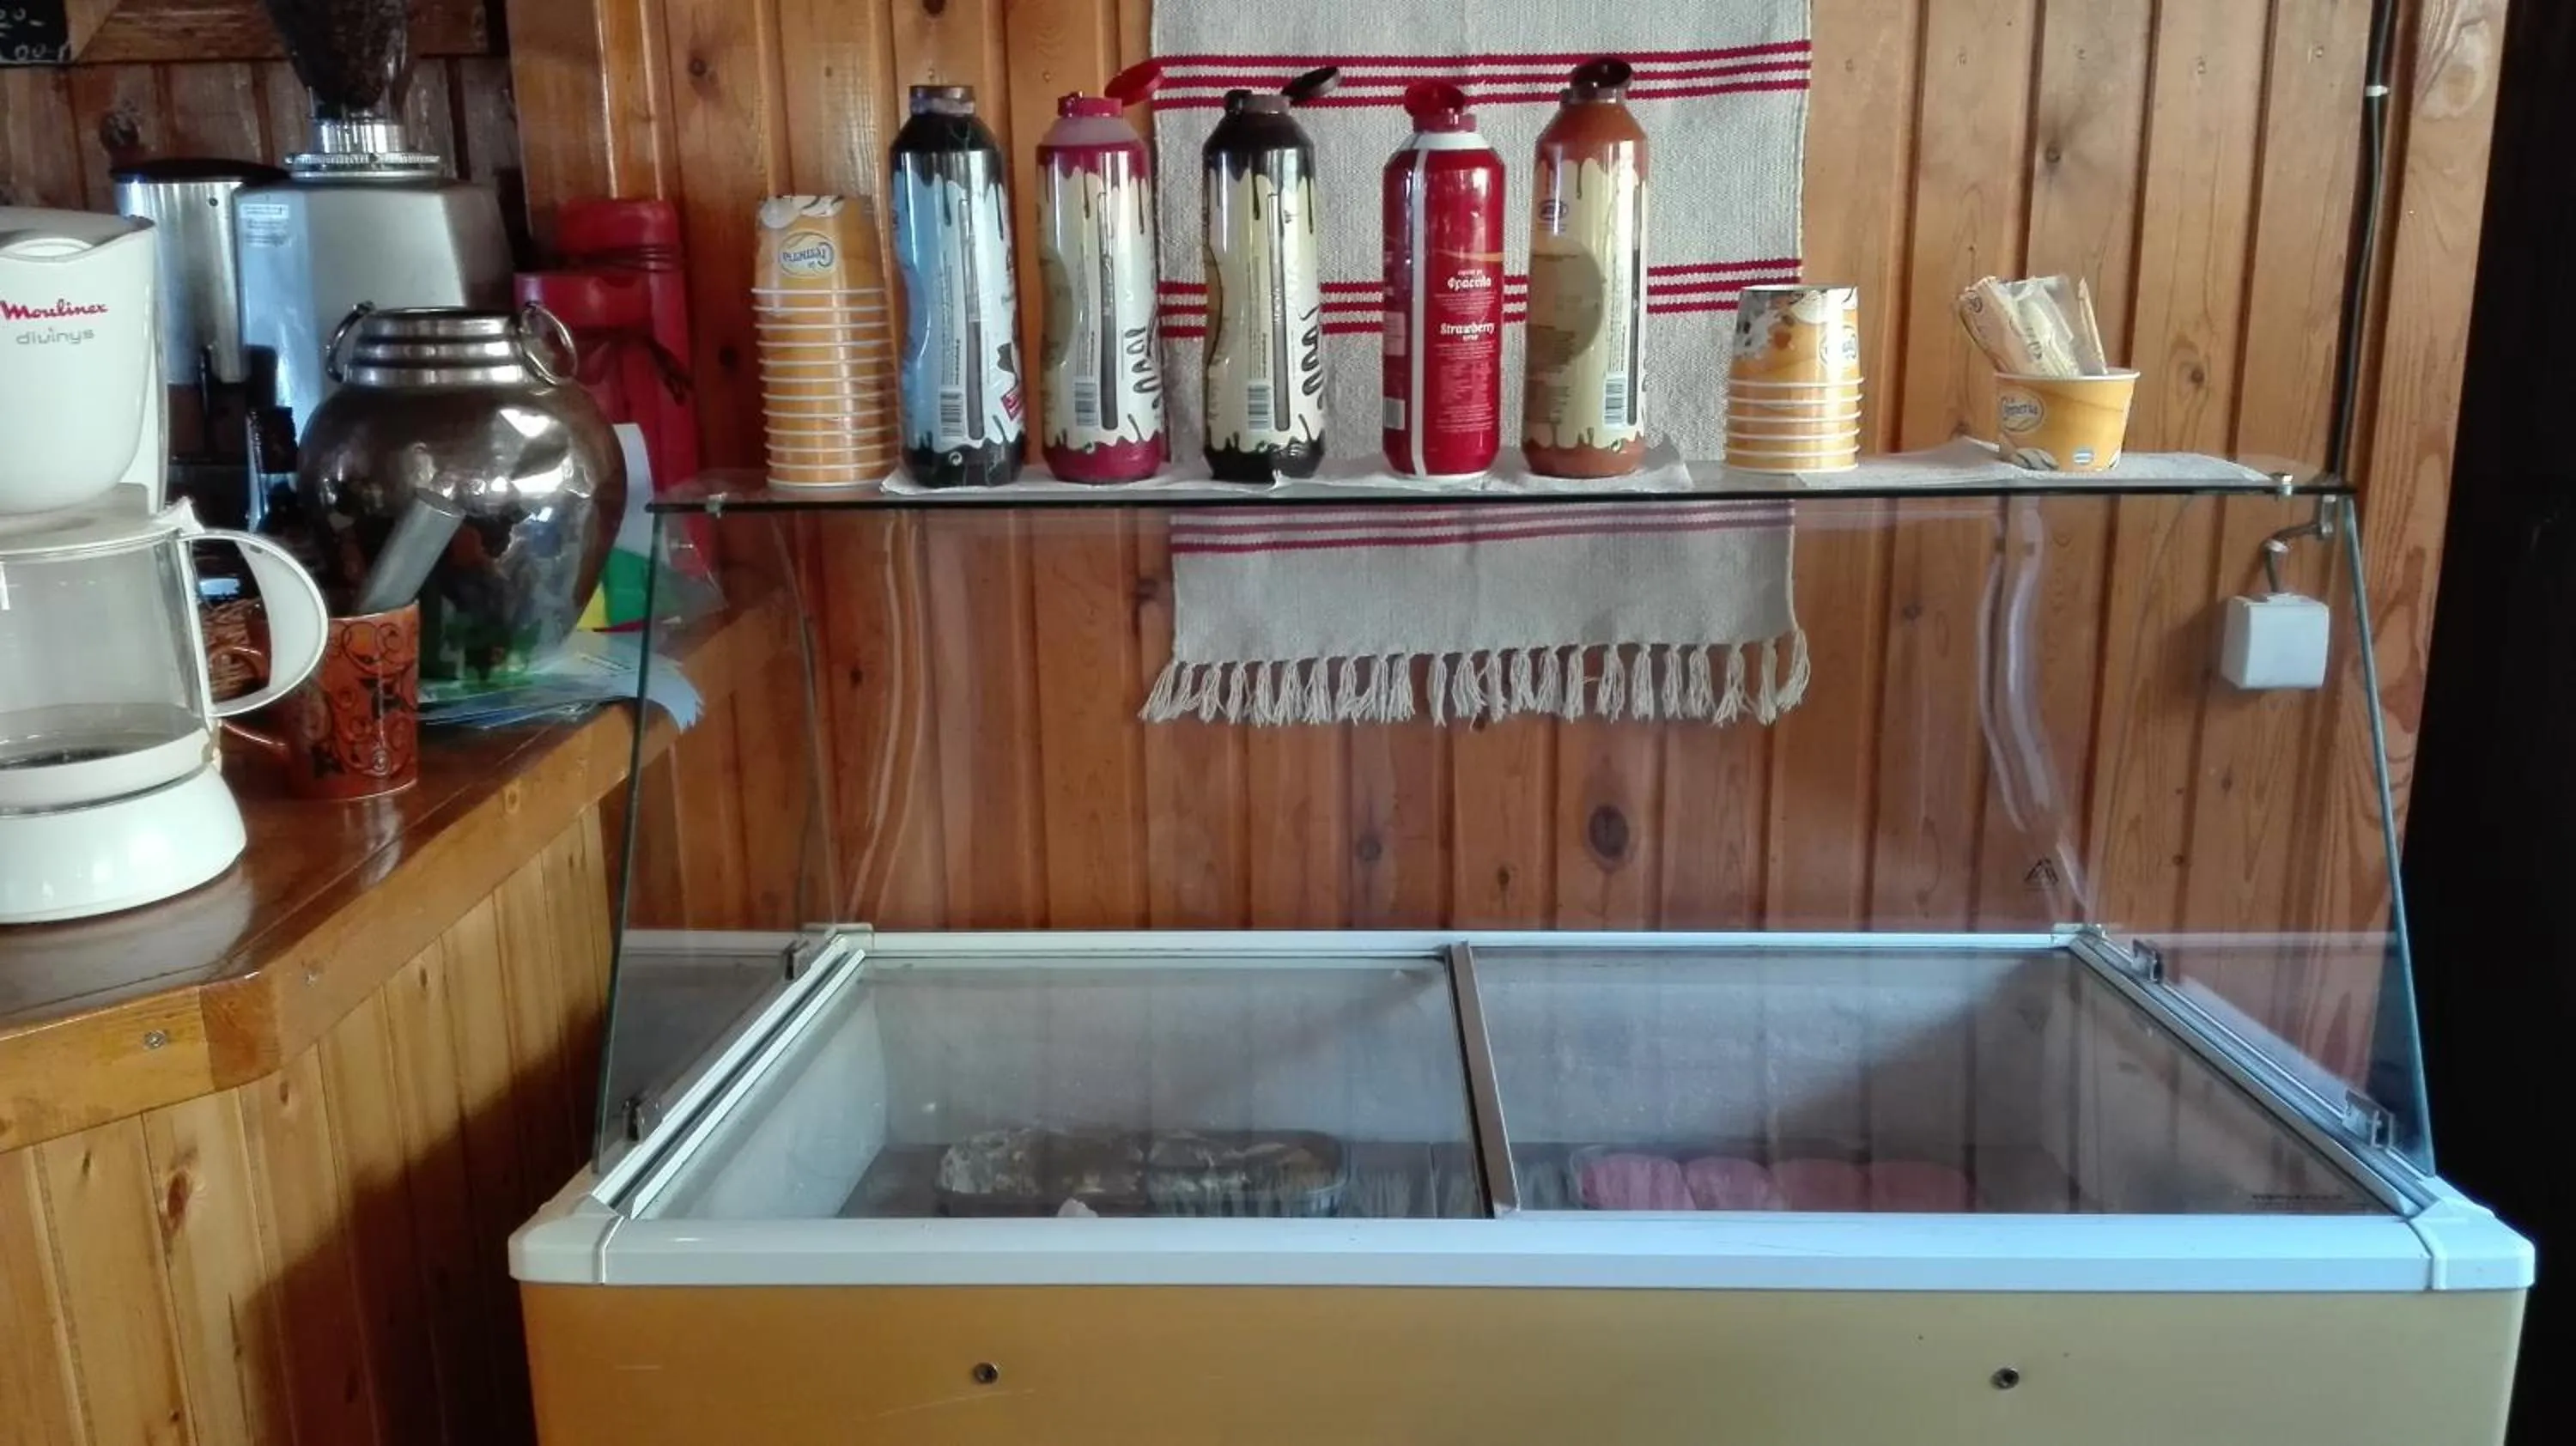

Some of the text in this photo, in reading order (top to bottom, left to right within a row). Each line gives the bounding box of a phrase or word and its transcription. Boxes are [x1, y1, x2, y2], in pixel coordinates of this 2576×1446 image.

[0, 298, 108, 320] Moulinex
[15, 327, 94, 344] divinys
[1439, 321, 1495, 335] Strawberry
